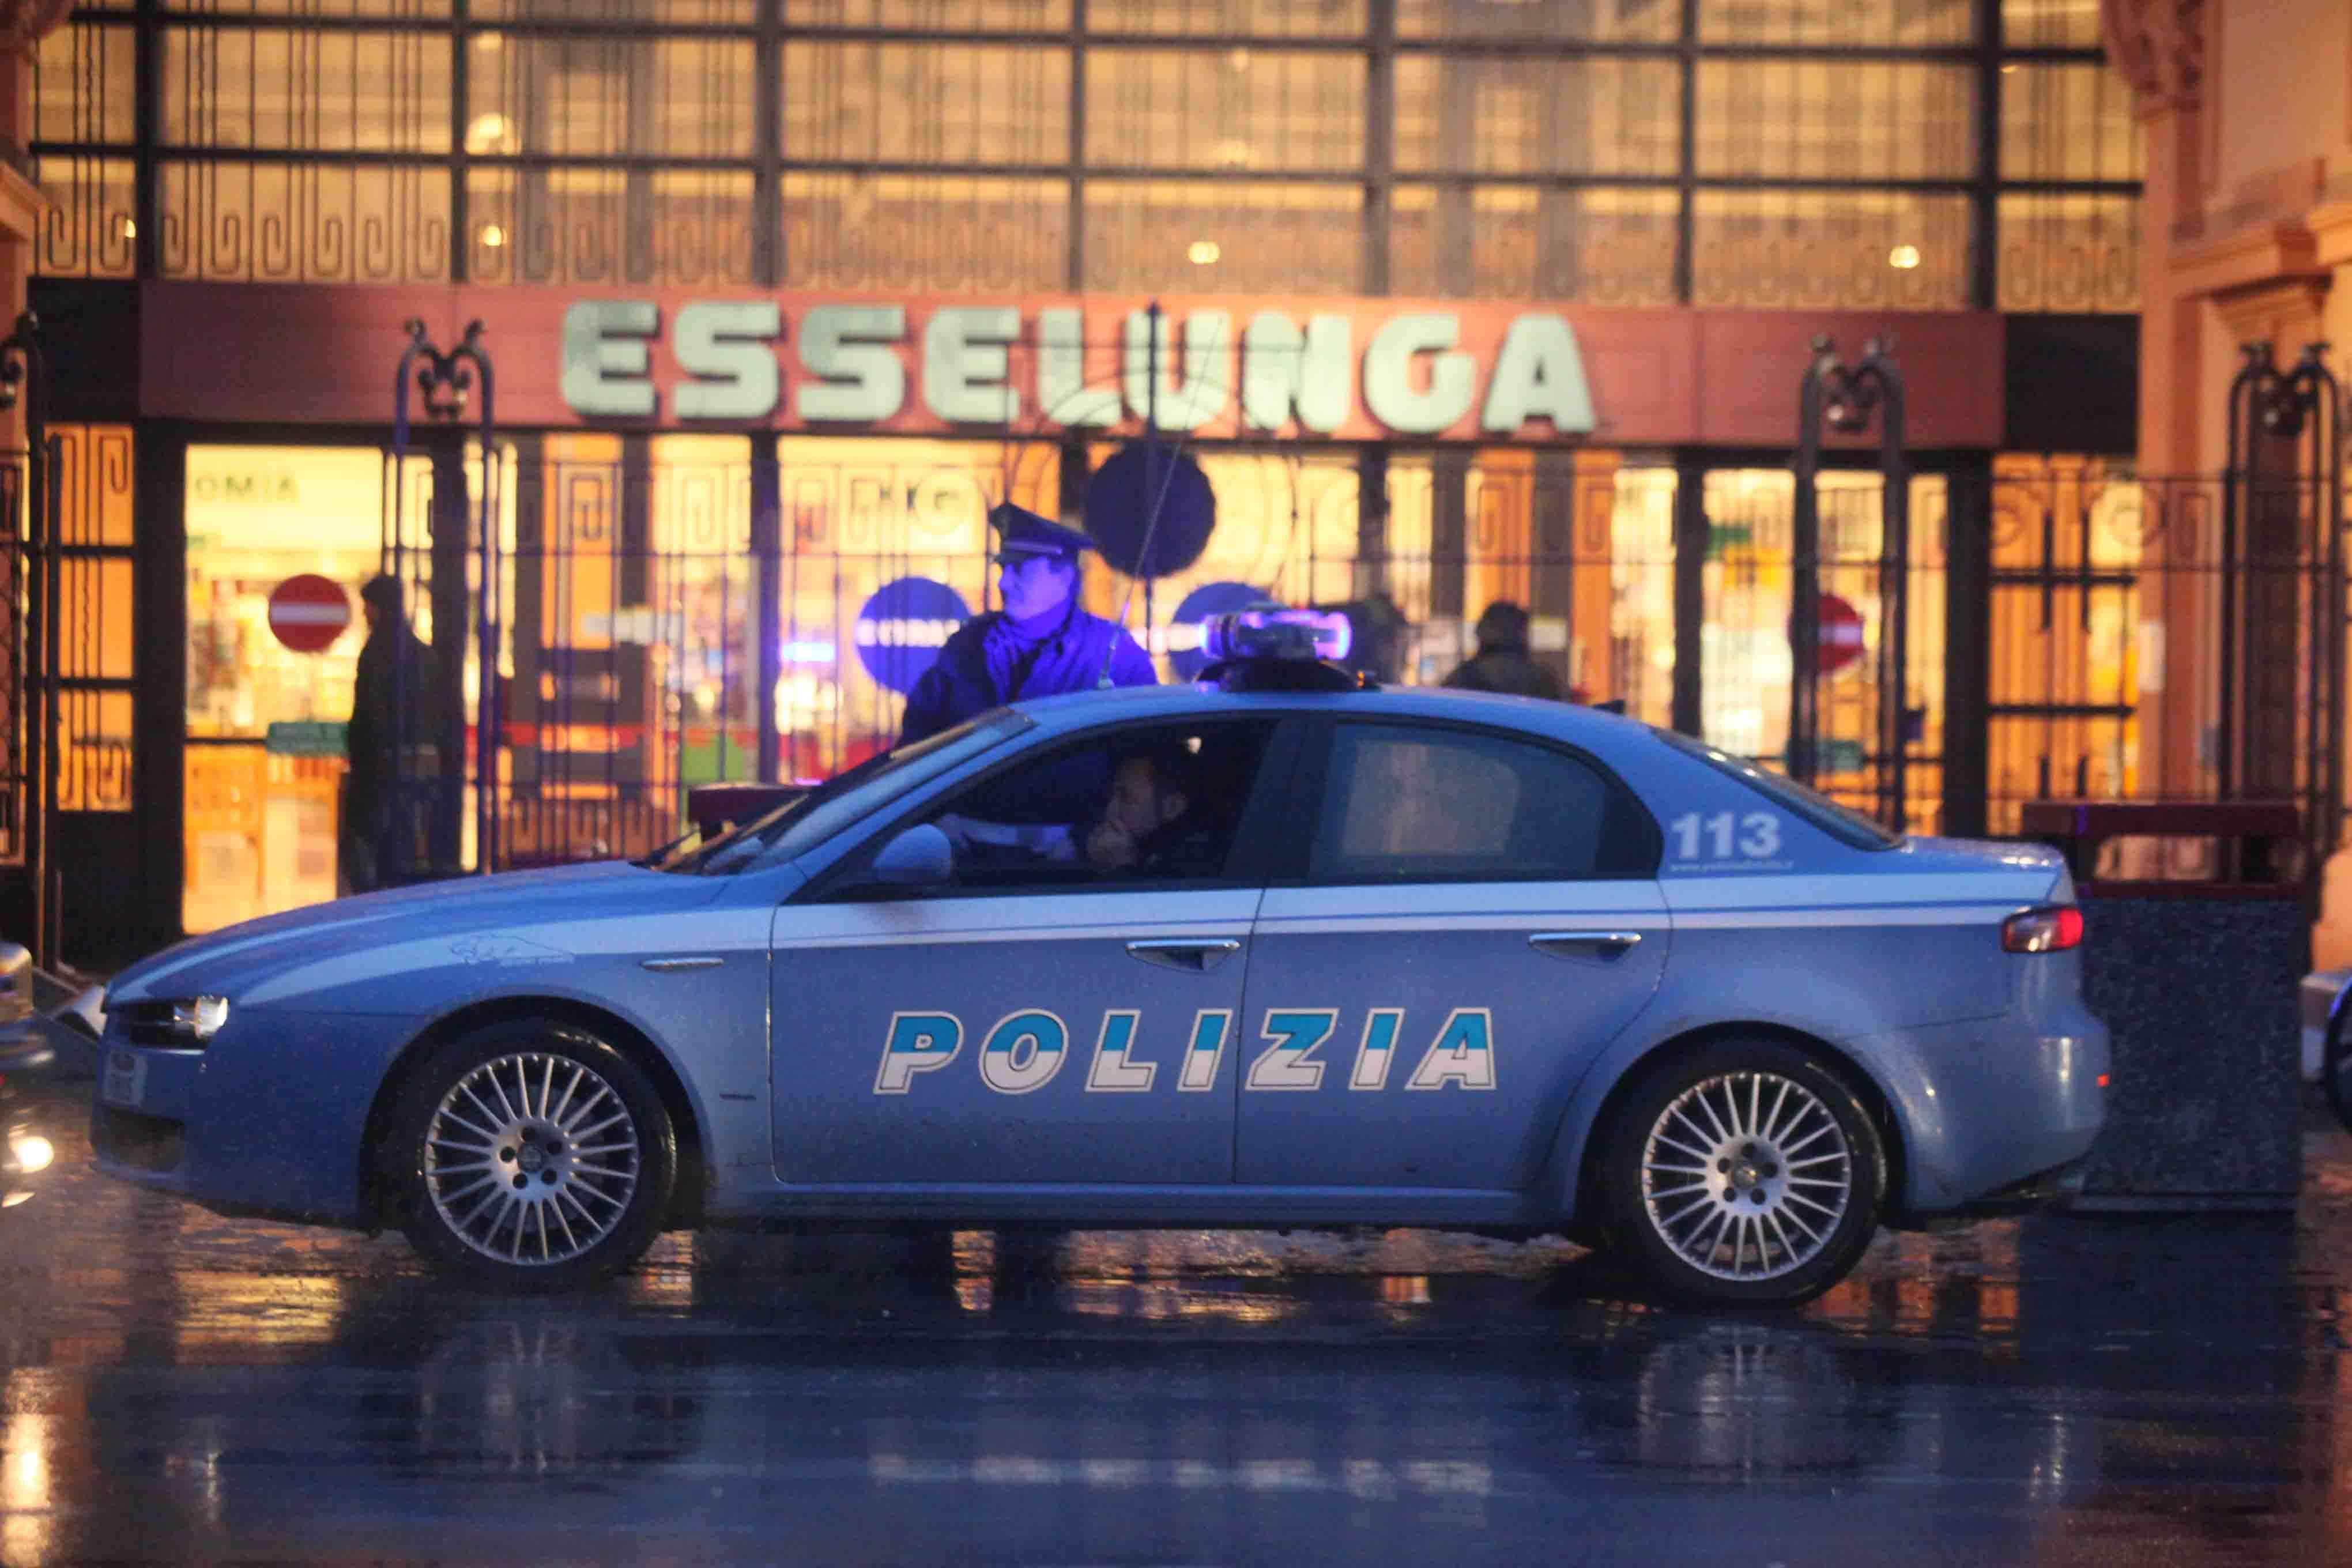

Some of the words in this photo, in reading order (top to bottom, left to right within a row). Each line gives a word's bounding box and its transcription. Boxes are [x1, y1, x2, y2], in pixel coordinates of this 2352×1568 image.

[560, 299, 1596, 432] ESSELUNGA
[1671, 811, 1780, 859] 113
[873, 1008, 1496, 1094] POLIZIA
